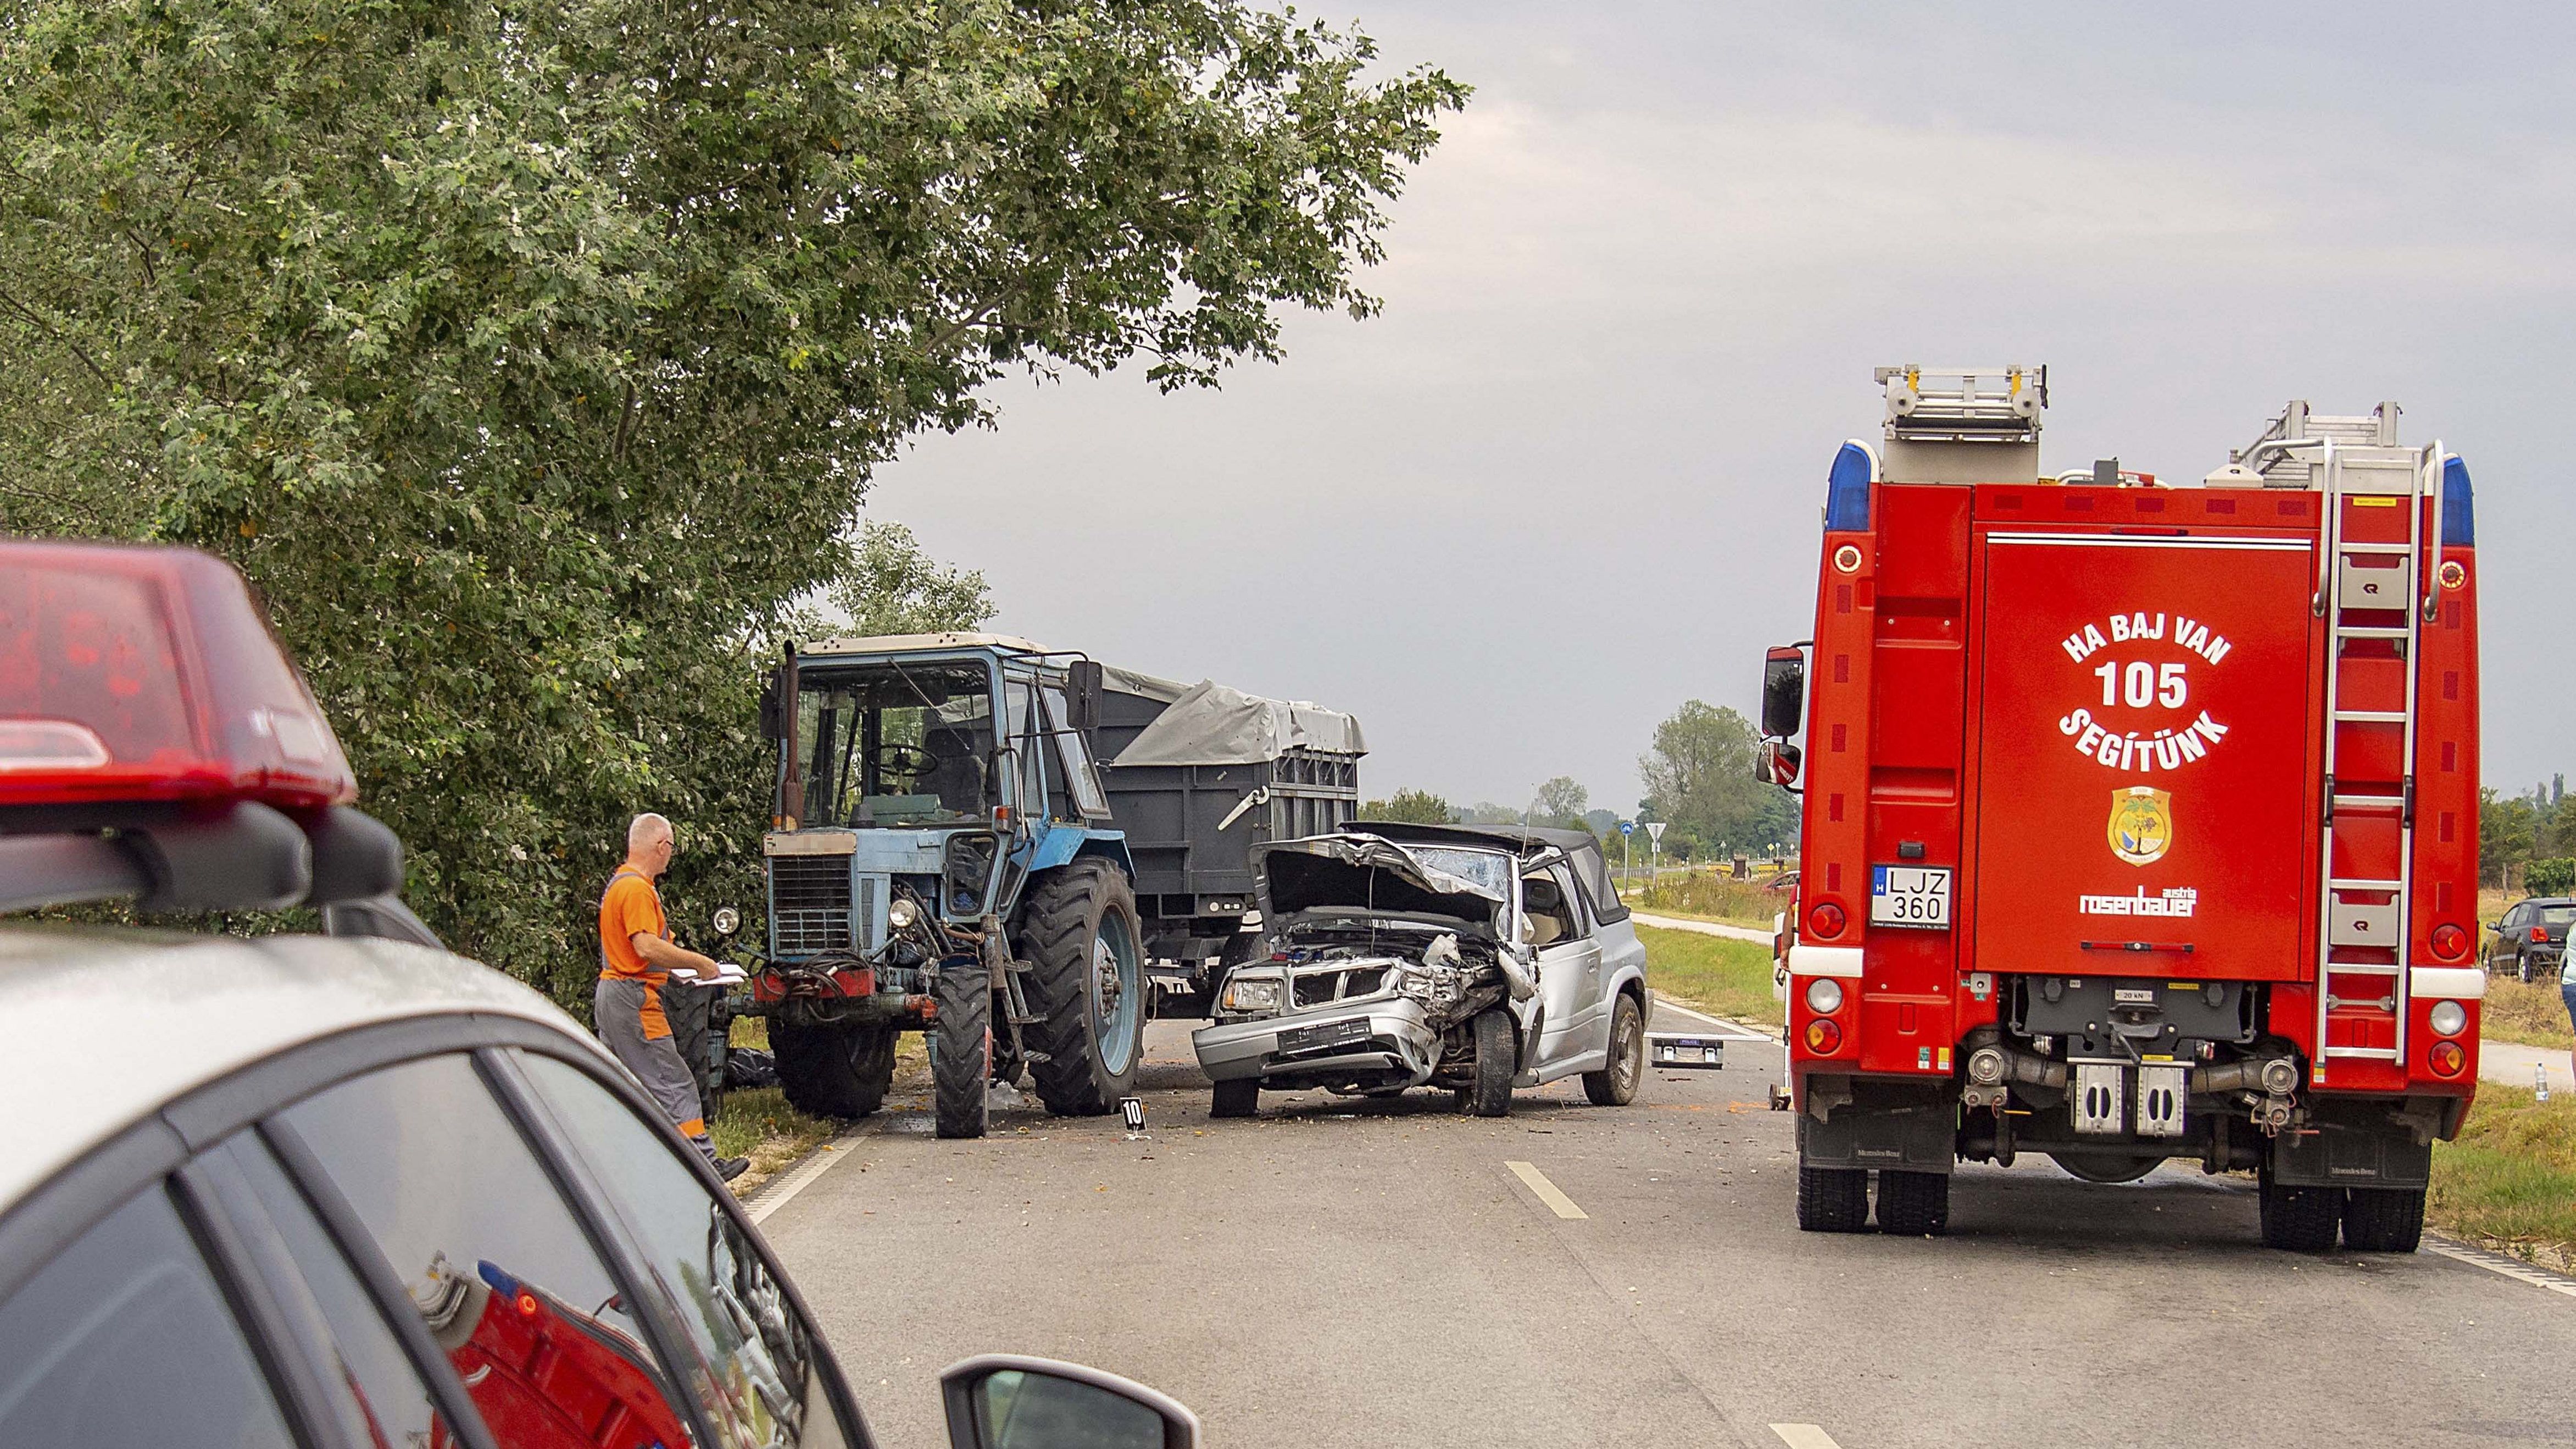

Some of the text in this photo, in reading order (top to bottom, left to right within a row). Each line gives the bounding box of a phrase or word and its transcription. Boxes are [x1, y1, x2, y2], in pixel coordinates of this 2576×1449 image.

[2062, 612, 2232, 665] HA BAJ VAN
[2095, 661, 2187, 709] 105
[2059, 708, 2229, 772] SEGÍTÜNK
[1877, 884, 1884, 892] H
[1890, 871, 1946, 895] LJZ
[1893, 896, 1940, 919] 360
[2080, 885, 2197, 917] rosenbauer
[1122, 1101, 1142, 1124] 10
